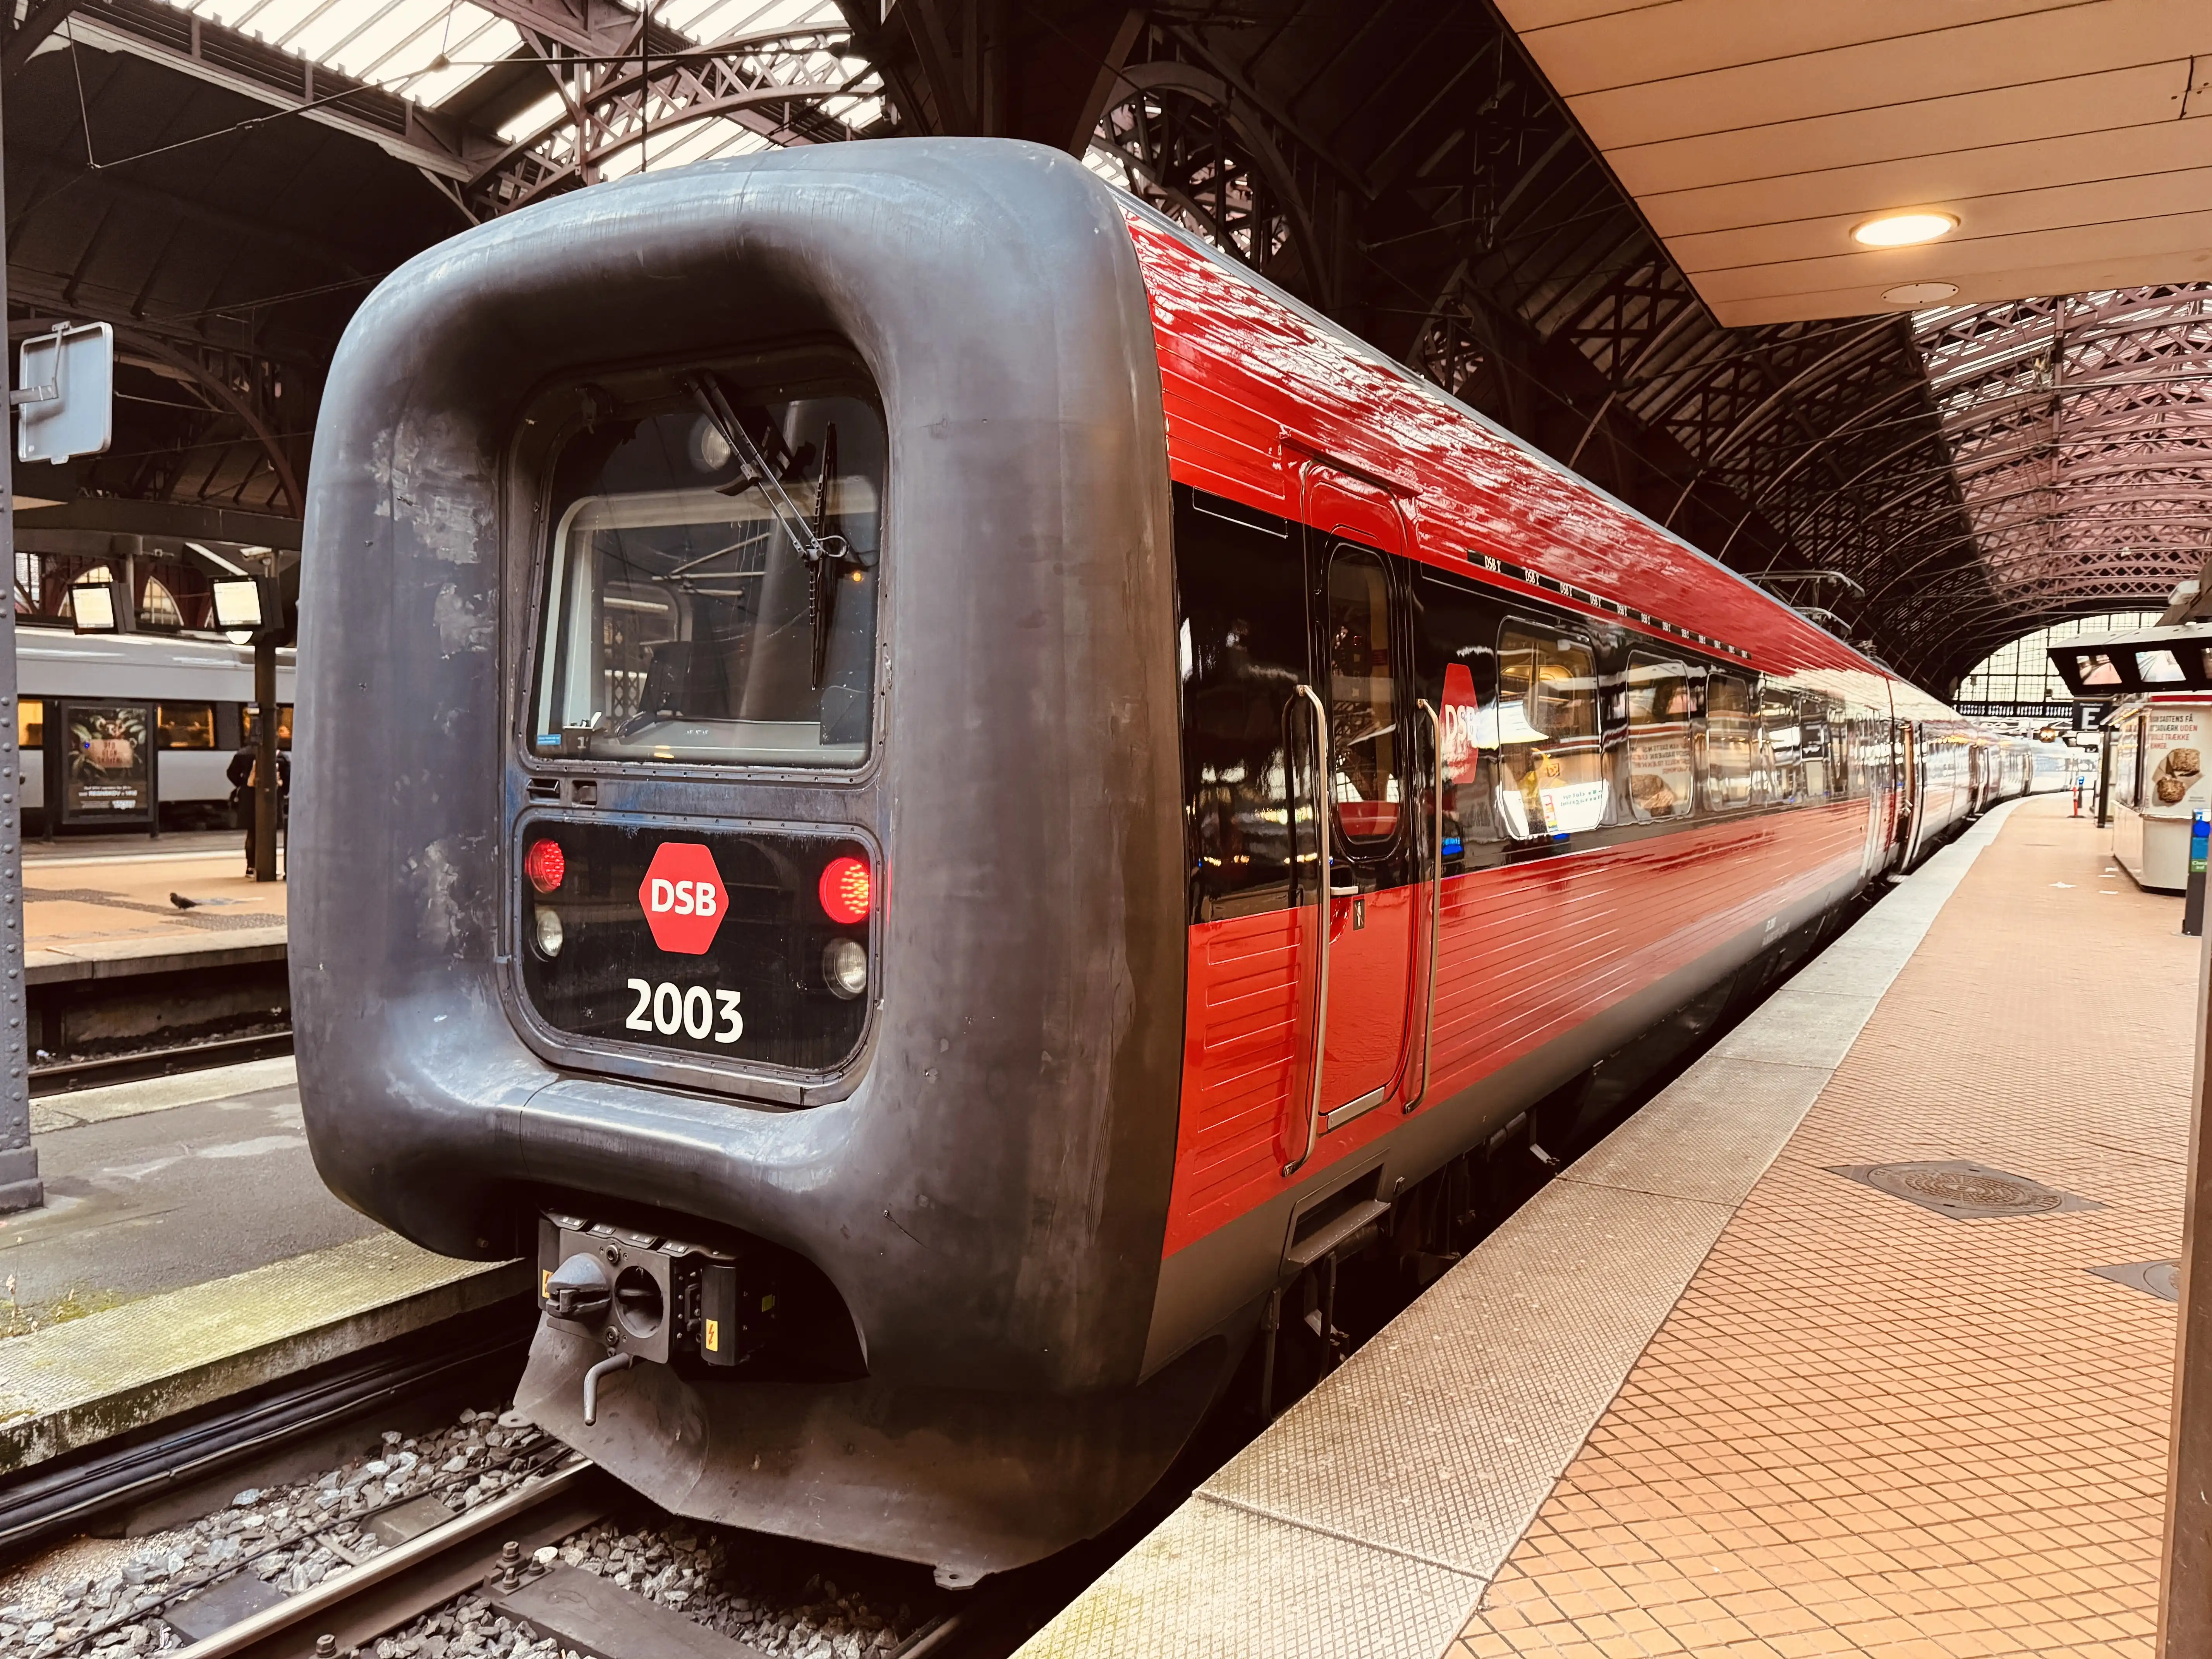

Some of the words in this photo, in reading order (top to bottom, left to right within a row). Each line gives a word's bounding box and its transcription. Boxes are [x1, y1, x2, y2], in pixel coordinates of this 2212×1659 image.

[1485, 555, 1496, 571] DSB
[1525, 570, 1535, 584] DSB
[1445, 704, 1477, 742] DSB
[2081, 707, 2100, 730] E
[2185, 713, 2193, 722] FÅ
[651, 878, 716, 917] DSB
[626, 978, 744, 1044] 2003
